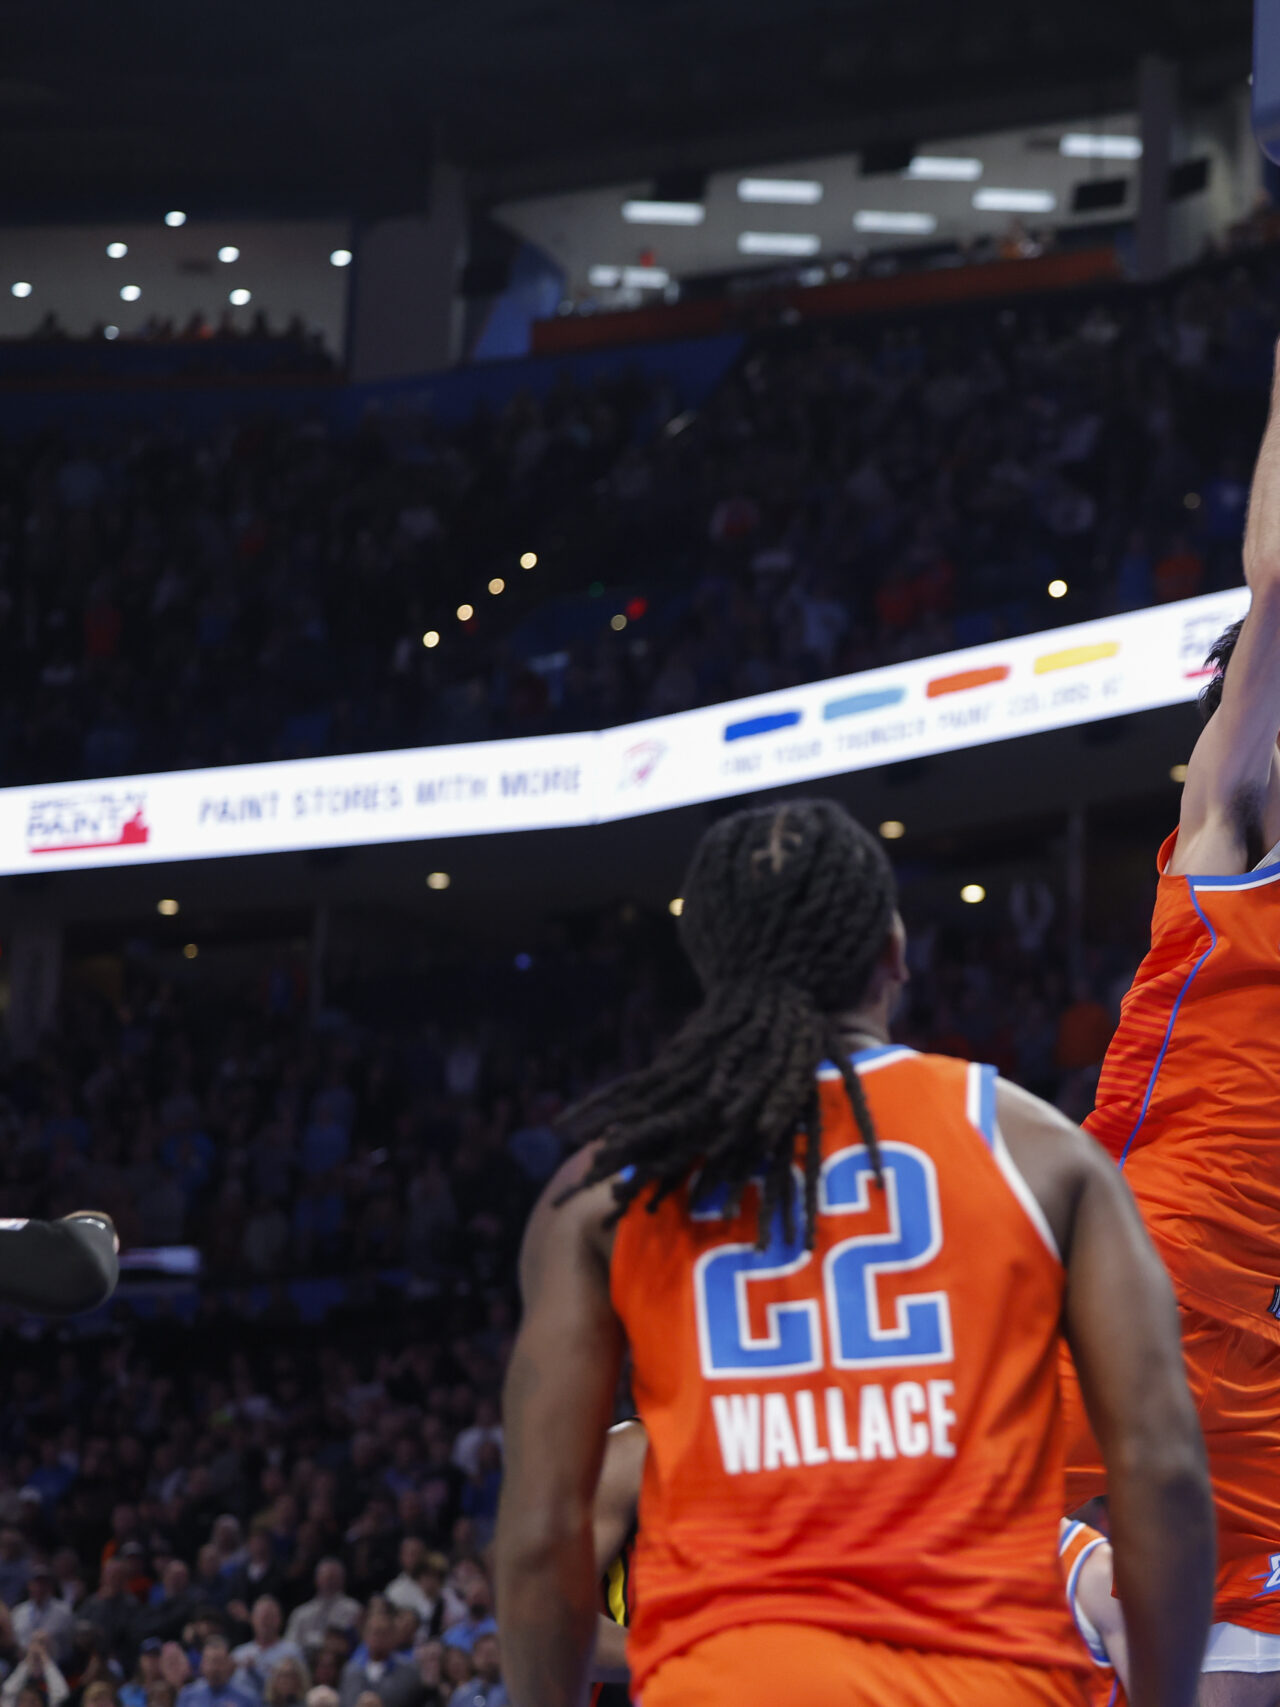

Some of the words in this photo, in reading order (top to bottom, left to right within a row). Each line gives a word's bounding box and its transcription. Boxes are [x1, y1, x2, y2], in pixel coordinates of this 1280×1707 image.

[198, 790, 279, 827] PAINT
[688, 1139, 955, 1379] 22
[711, 1379, 957, 1475] WALLACE
